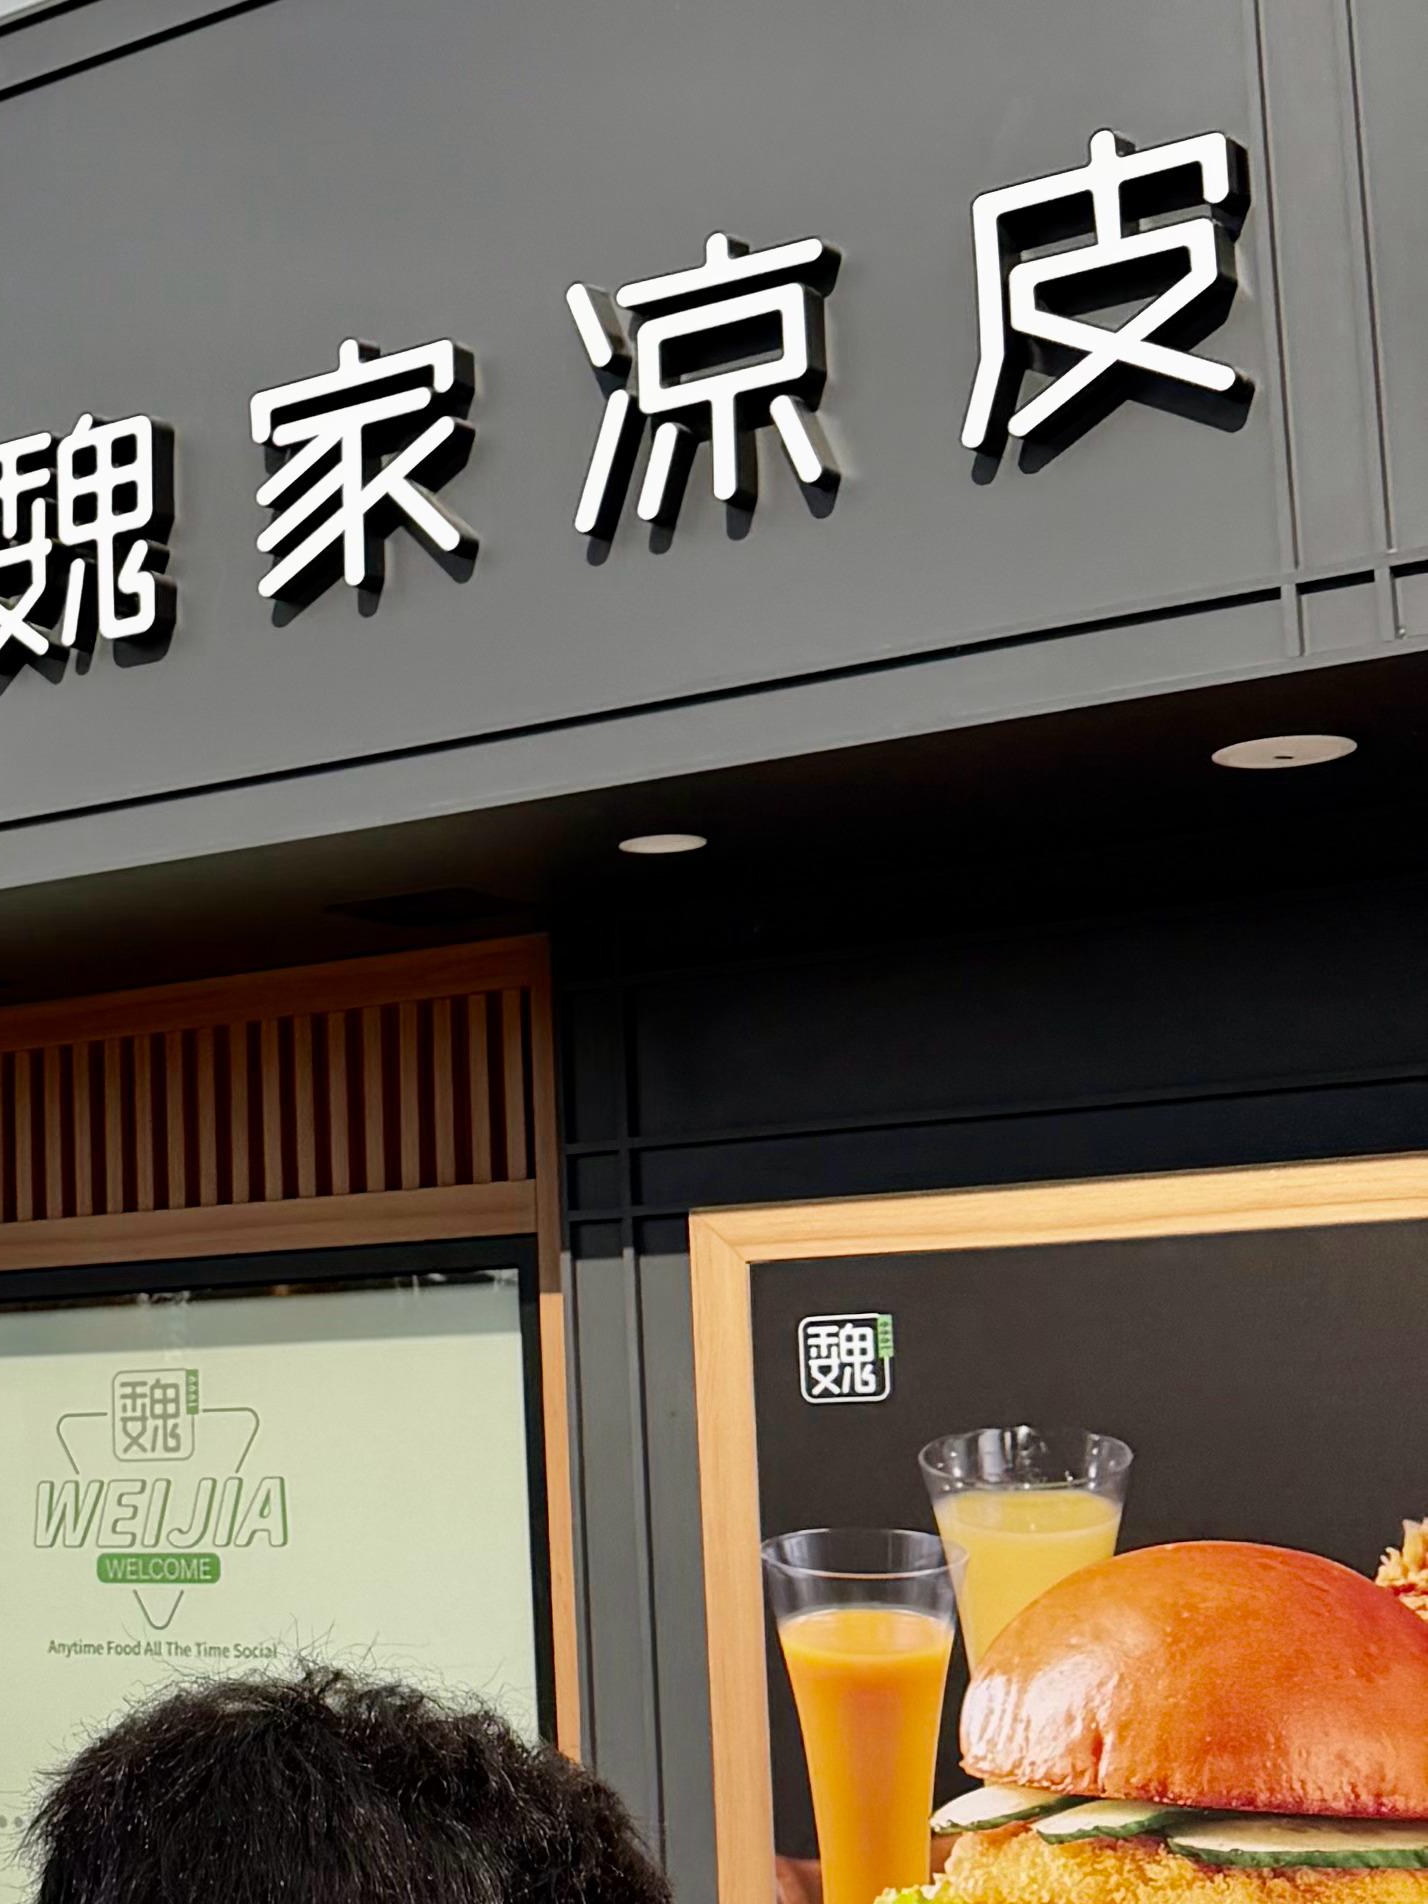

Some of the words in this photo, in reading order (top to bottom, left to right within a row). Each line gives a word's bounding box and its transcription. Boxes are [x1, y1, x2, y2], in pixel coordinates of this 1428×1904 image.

[806, 1322, 877, 1396] 魏
[119, 1378, 181, 1454] 魏
[34, 1476, 289, 1549] WEIJIA
[105, 1557, 213, 1581] WELCOME
[48, 1639, 104, 1658] Anytime
[106, 1641, 142, 1656] Food
[144, 1641, 162, 1656] All
[165, 1641, 193, 1657] The
[194, 1642, 230, 1658] Time
[233, 1643, 278, 1660] Social
